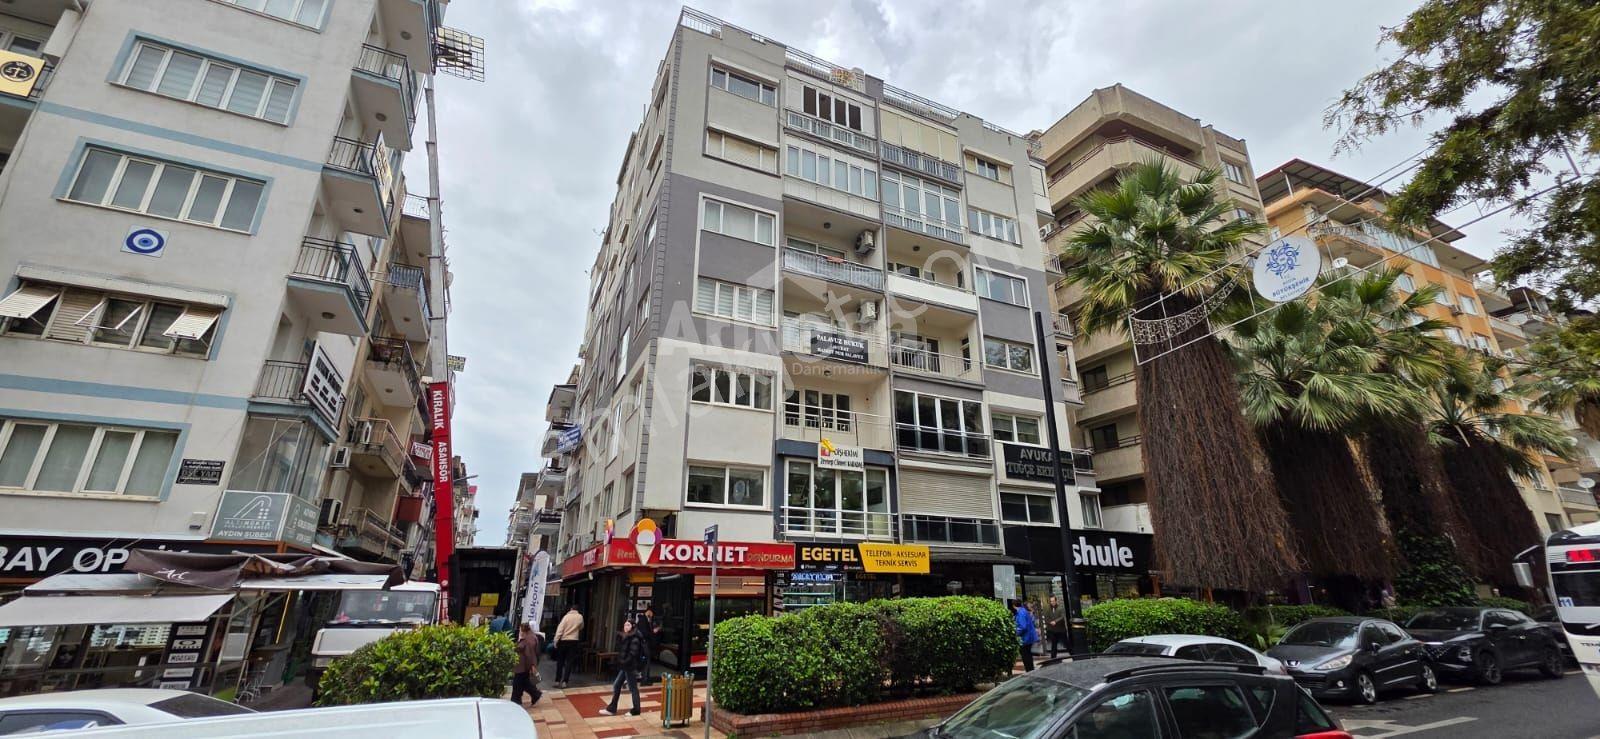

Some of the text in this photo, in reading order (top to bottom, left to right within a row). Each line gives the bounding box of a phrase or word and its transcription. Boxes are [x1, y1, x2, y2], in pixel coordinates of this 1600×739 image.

[433, 389, 449, 482] KİRALIK ASANSÖR
[1020, 448, 1055, 462] AVUKA
[217, 530, 243, 538] AYDIN
[659, 544, 749, 563] KORNET
[801, 547, 858, 562] EGETEL
[866, 549, 927, 559] TELEFON AKSESUAR
[876, 558, 918, 567] TEKNİK SERVİS
